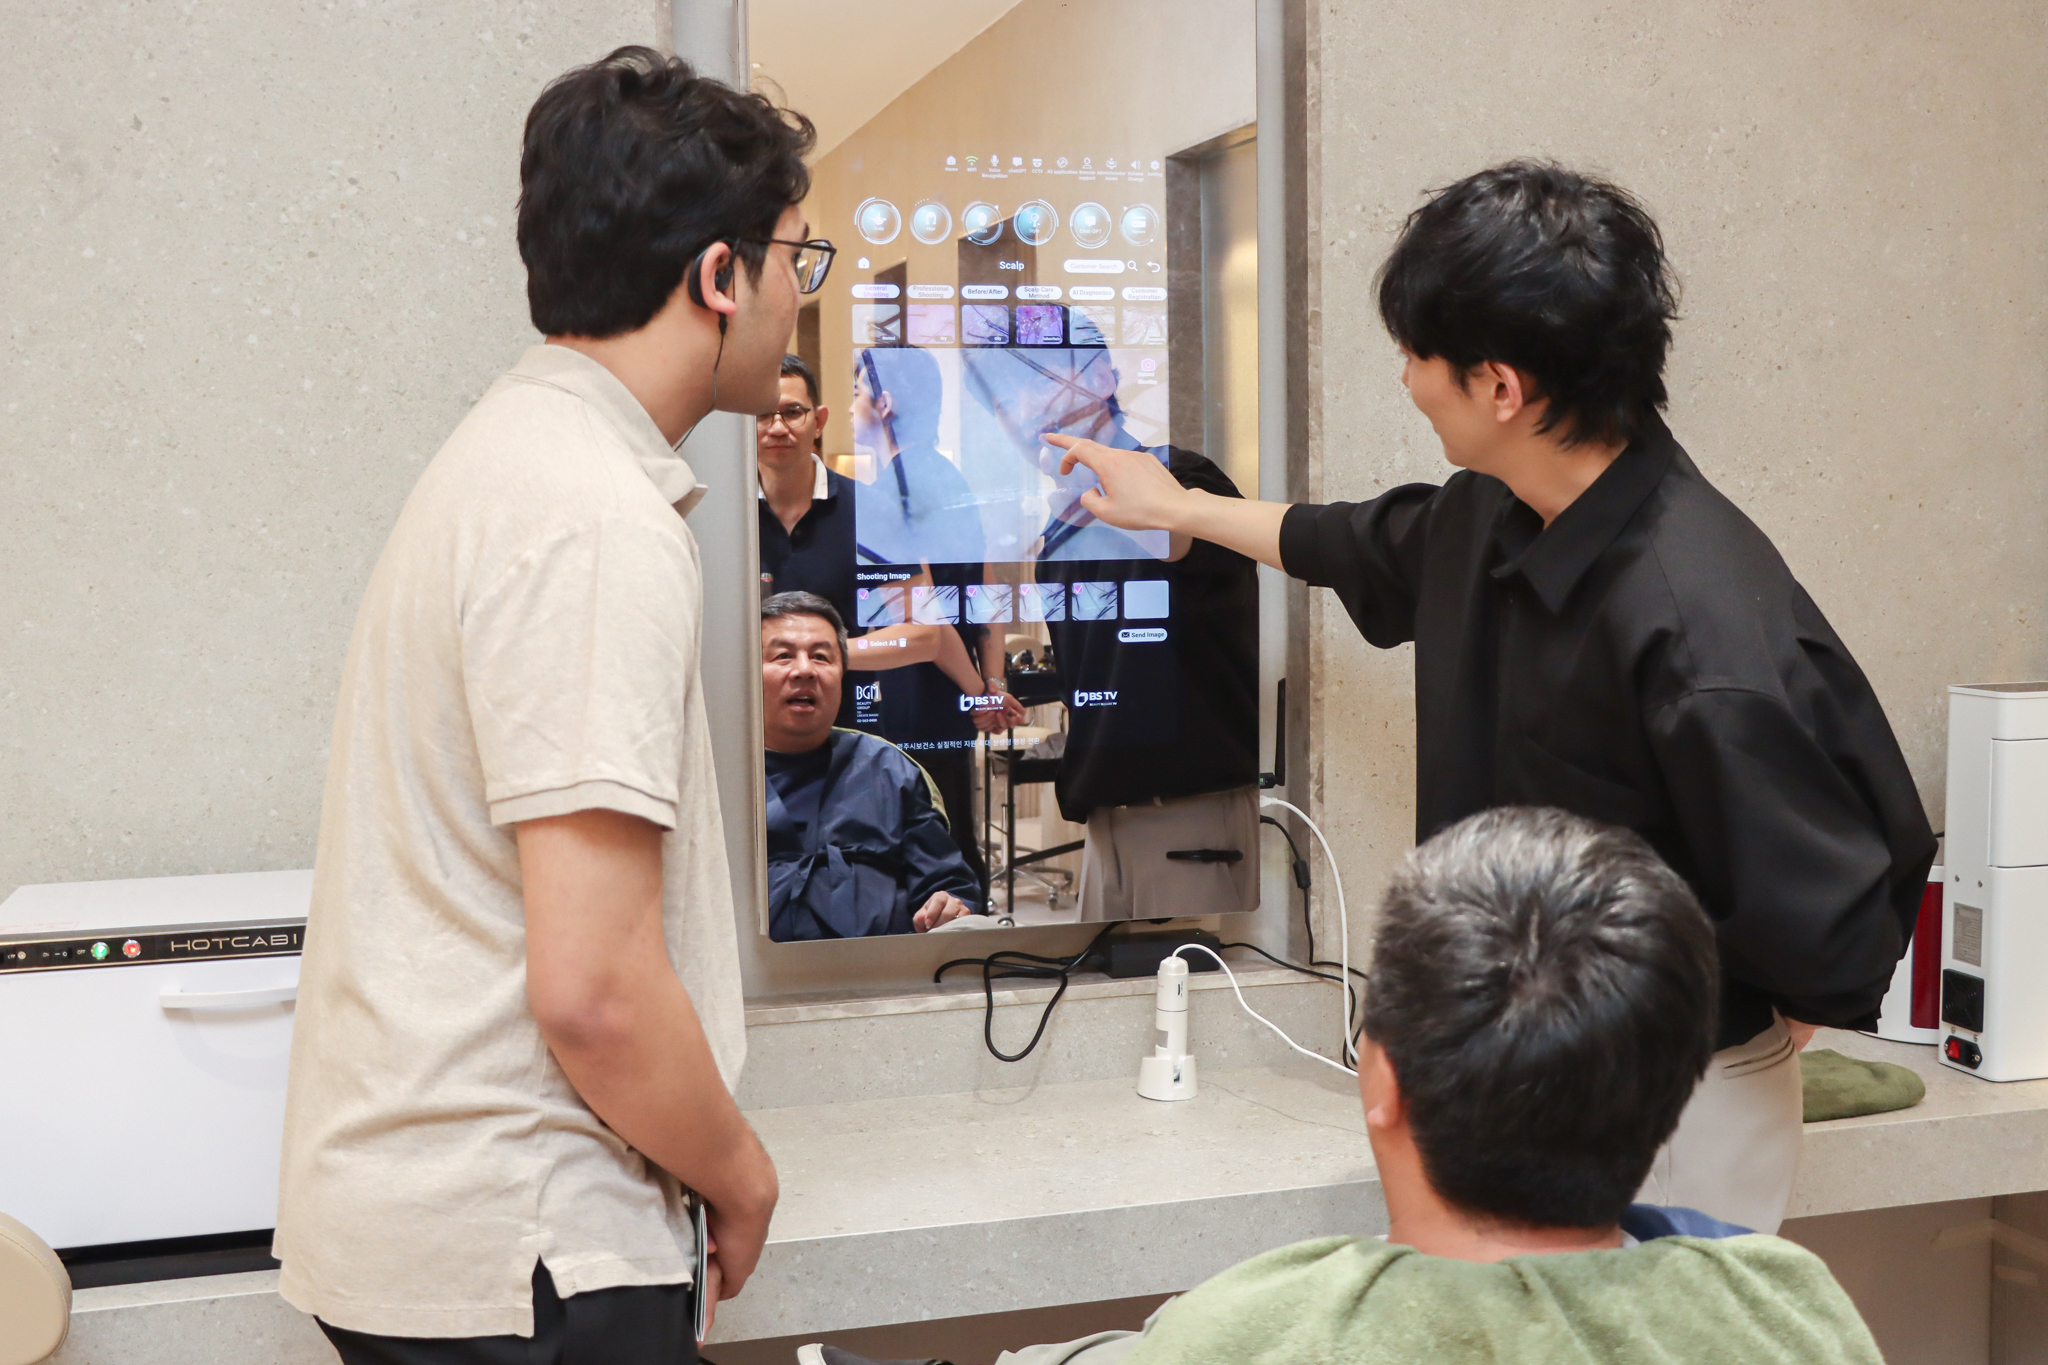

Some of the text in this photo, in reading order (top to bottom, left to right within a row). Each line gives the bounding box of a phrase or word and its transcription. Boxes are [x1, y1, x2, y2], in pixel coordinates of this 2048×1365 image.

[999, 260, 1025, 272] Scalp
[856, 573, 911, 581] Shooting Image
[975, 696, 989, 705] BS
[989, 695, 1004, 705] TV
[1089, 691, 1103, 701] BS
[1103, 691, 1118, 700] TV
[937, 740, 962, 749] 실질적인
[964, 739, 976, 748] 지원
